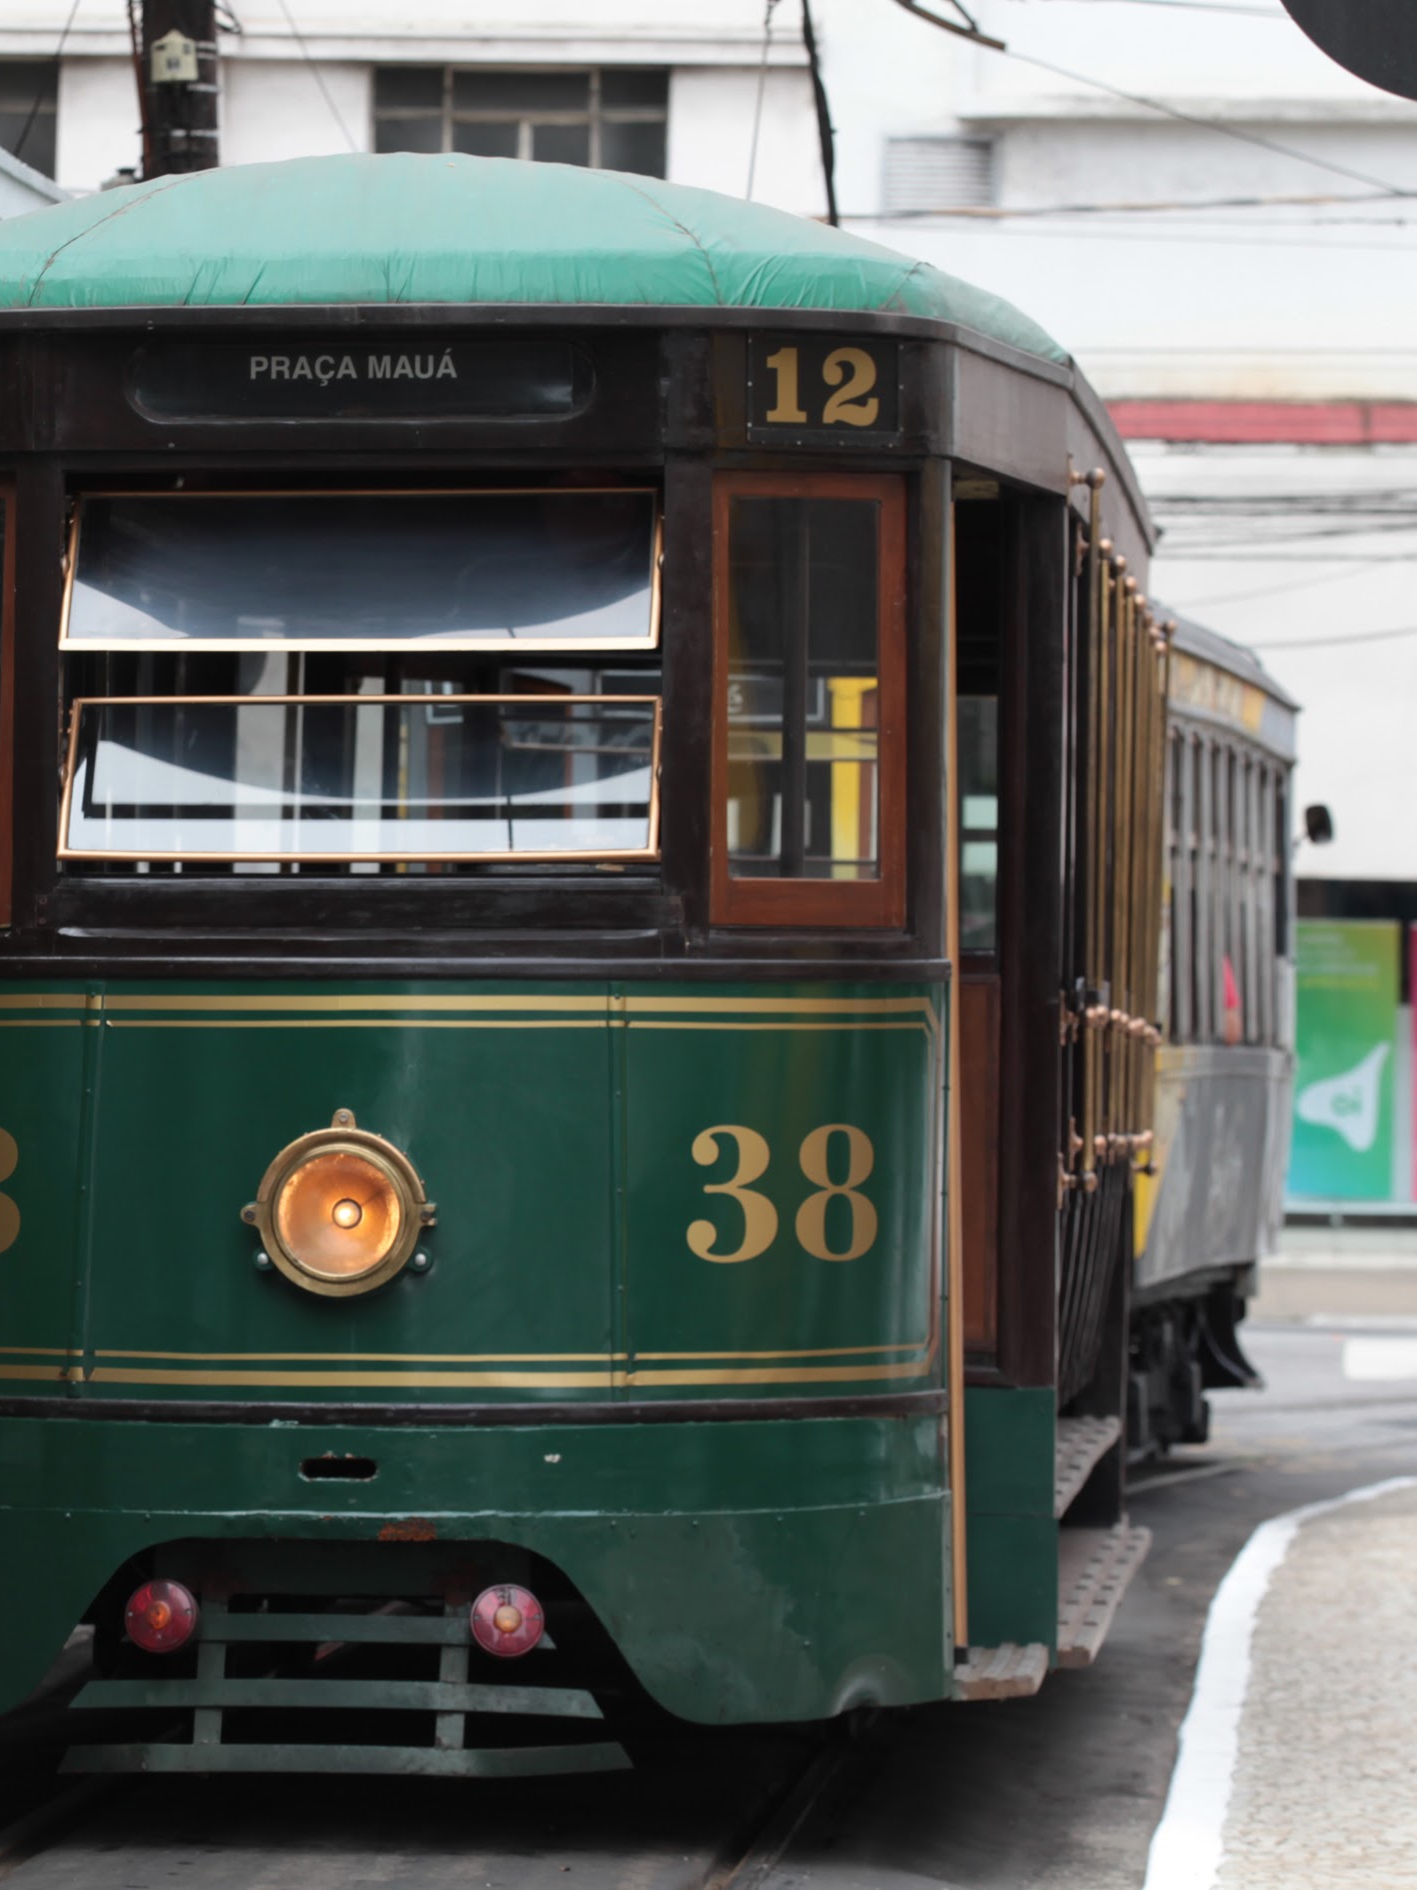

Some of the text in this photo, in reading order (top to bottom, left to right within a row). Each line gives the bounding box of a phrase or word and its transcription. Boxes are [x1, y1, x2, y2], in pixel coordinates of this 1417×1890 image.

[250, 348, 458, 386] PRAÇA MAUÁ
[766, 347, 879, 427] 12
[686, 1123, 878, 1263] 38
